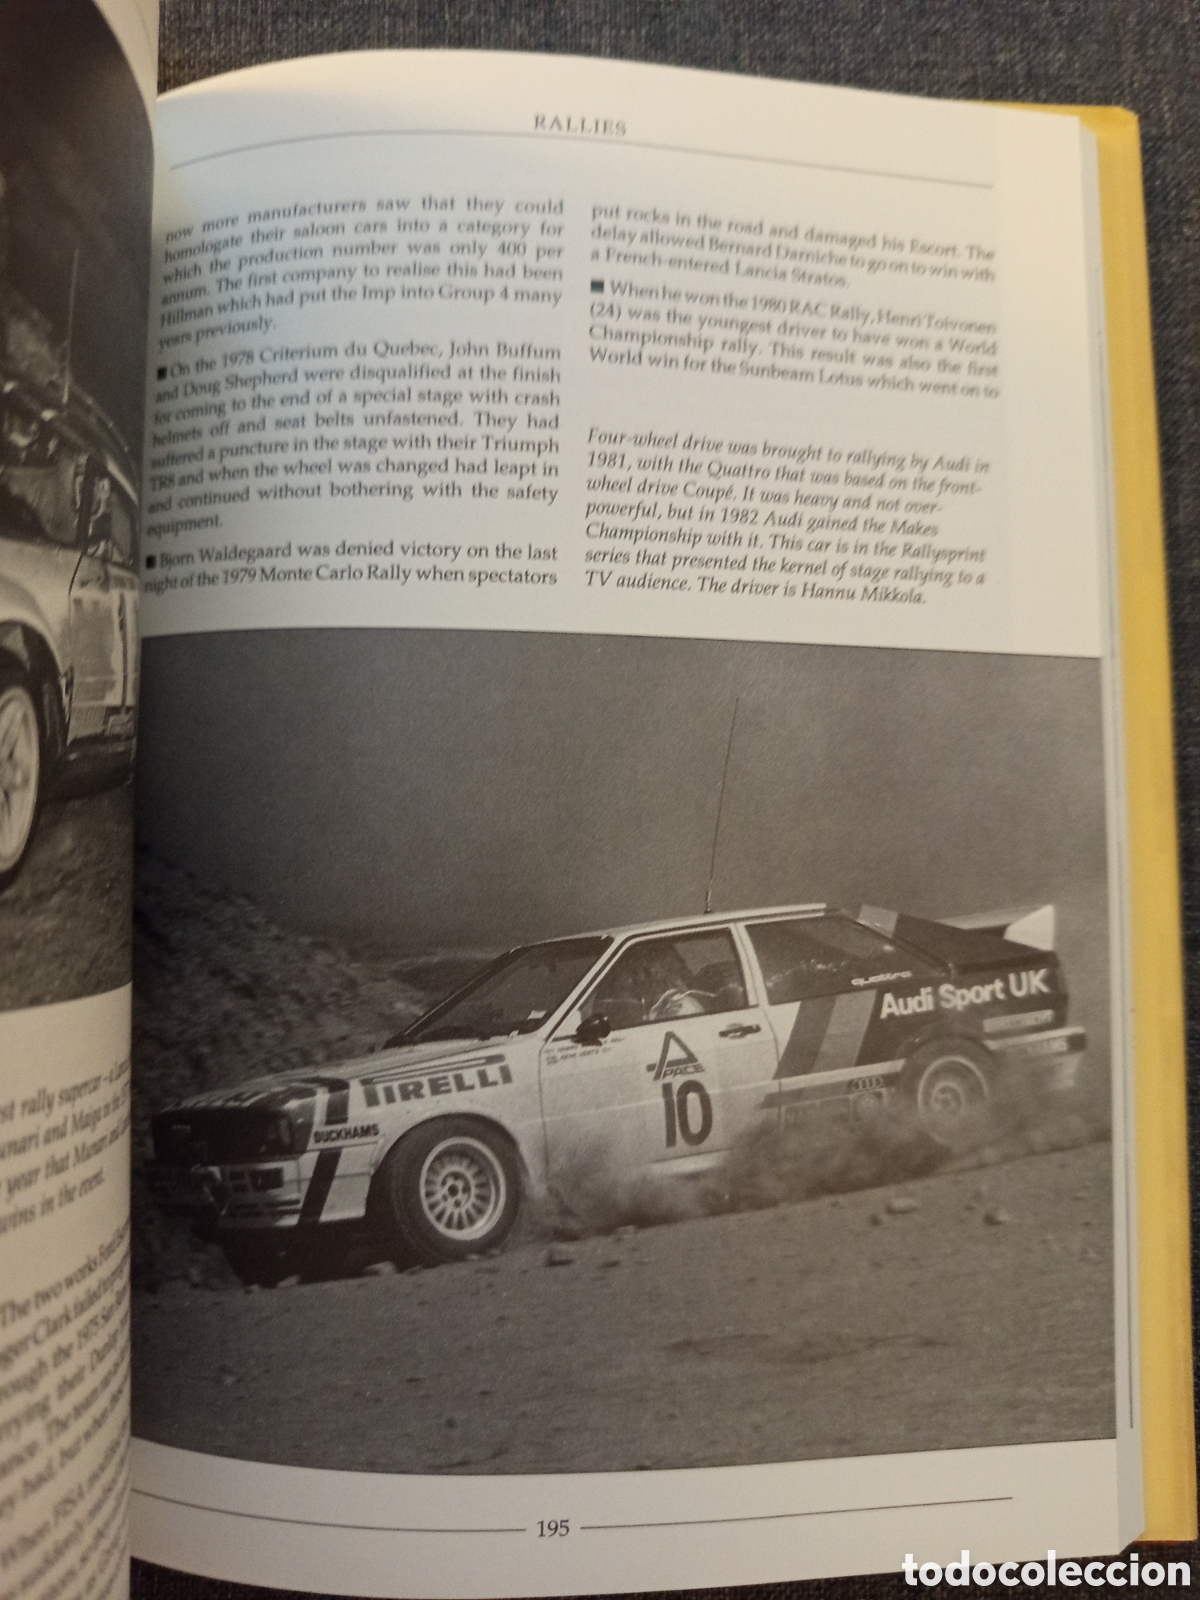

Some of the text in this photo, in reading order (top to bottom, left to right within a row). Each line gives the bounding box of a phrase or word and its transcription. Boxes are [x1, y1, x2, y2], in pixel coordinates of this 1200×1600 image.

[534, 114, 627, 138] RALLIES
[202, 215, 239, 233] more
[247, 201, 366, 224] manufacturers
[376, 200, 410, 212] saw
[421, 195, 456, 210] that
[466, 196, 504, 216] they
[515, 198, 564, 214] could
[209, 419, 230, 437] off
[237, 415, 266, 433] and
[274, 414, 306, 429] seat
[314, 411, 354, 426] belts
[477, 411, 517, 431] They
[527, 412, 559, 428] had
[207, 448, 216, 460] a
[218, 441, 289, 463] puncture
[293, 437, 309, 451] in
[313, 434, 339, 450] the
[343, 436, 388, 453] stage
[392, 433, 431, 448] with
[437, 434, 476, 449] their
[485, 434, 559, 456] Triumph
[588, 428, 991, 474] Four-wheel drive was brought to rallying by Audi in
[208, 465, 249, 482] when
[253, 461, 279, 477] the
[283, 457, 332, 474] wheel
[338, 461, 371, 472] was
[376, 456, 448, 476] changed
[455, 457, 487, 473] had
[495, 458, 537, 479] leapt
[543, 461, 558, 476] in
[637, 456, 673, 472] with
[679, 458, 702, 474] the
[707, 460, 770, 479] Quattro
[775, 465, 805, 482] that
[810, 472, 840, 485] was
[844, 470, 885, 488] based
[889, 478, 908, 490] on
[912, 475, 935, 491] the
[258, 482, 322, 500] without
[330, 481, 413, 500] bothering
[423, 481, 462, 496] with
[472, 482, 499, 497] the
[507, 483, 558, 504] safety
[587, 476, 631, 493] wheel
[637, 479, 678, 496] drive
[743, 486, 754, 502] It
[760, 491, 790, 504] was
[794, 489, 839, 512] heavy
[842, 494, 871, 509] and
[876, 498, 901, 511] not
[667, 506, 693, 522] but
[699, 508, 714, 523] in
[721, 509, 758, 525] 1982
[764, 511, 802, 529] Audi
[807, 517, 857, 535] gained
[862, 519, 886, 534] the
[890, 520, 939, 537] Makes
[297, 544, 330, 556] was
[335, 540, 394, 555] denied
[401, 541, 461, 561] victory
[467, 546, 489, 557] on
[496, 542, 522, 558] the
[528, 544, 557, 560] last
[586, 524, 702, 551] Championship
[707, 533, 742, 548] with
[771, 535, 803, 552] This
[807, 541, 830, 553] car
[836, 540, 849, 555] is
[853, 541, 869, 556] in
[873, 542, 897, 557] the
[901, 543, 986, 566] Rallysprint
[222, 566, 256, 583] 1979
[260, 565, 312, 581] Monte
[315, 563, 363, 579] Carlo
[367, 563, 411, 583] Rally
[416, 564, 464, 580] when
[469, 569, 557, 586] spectators
[585, 550, 986, 590] series that presented the kernel of stage rallying to a
[587, 571, 609, 587] TV
[700, 578, 726, 594] The
[731, 580, 777, 597] driver
[783, 583, 796, 598] is
[802, 584, 856, 601] Hannu
[880, 967, 1050, 1020] Audi Sport UK
[359, 1053, 513, 1109] PIRELLI
[661, 1079, 713, 1148] 10
[314, 1123, 380, 1145] DUCKHAMS
[537, 1519, 570, 1538] 195
